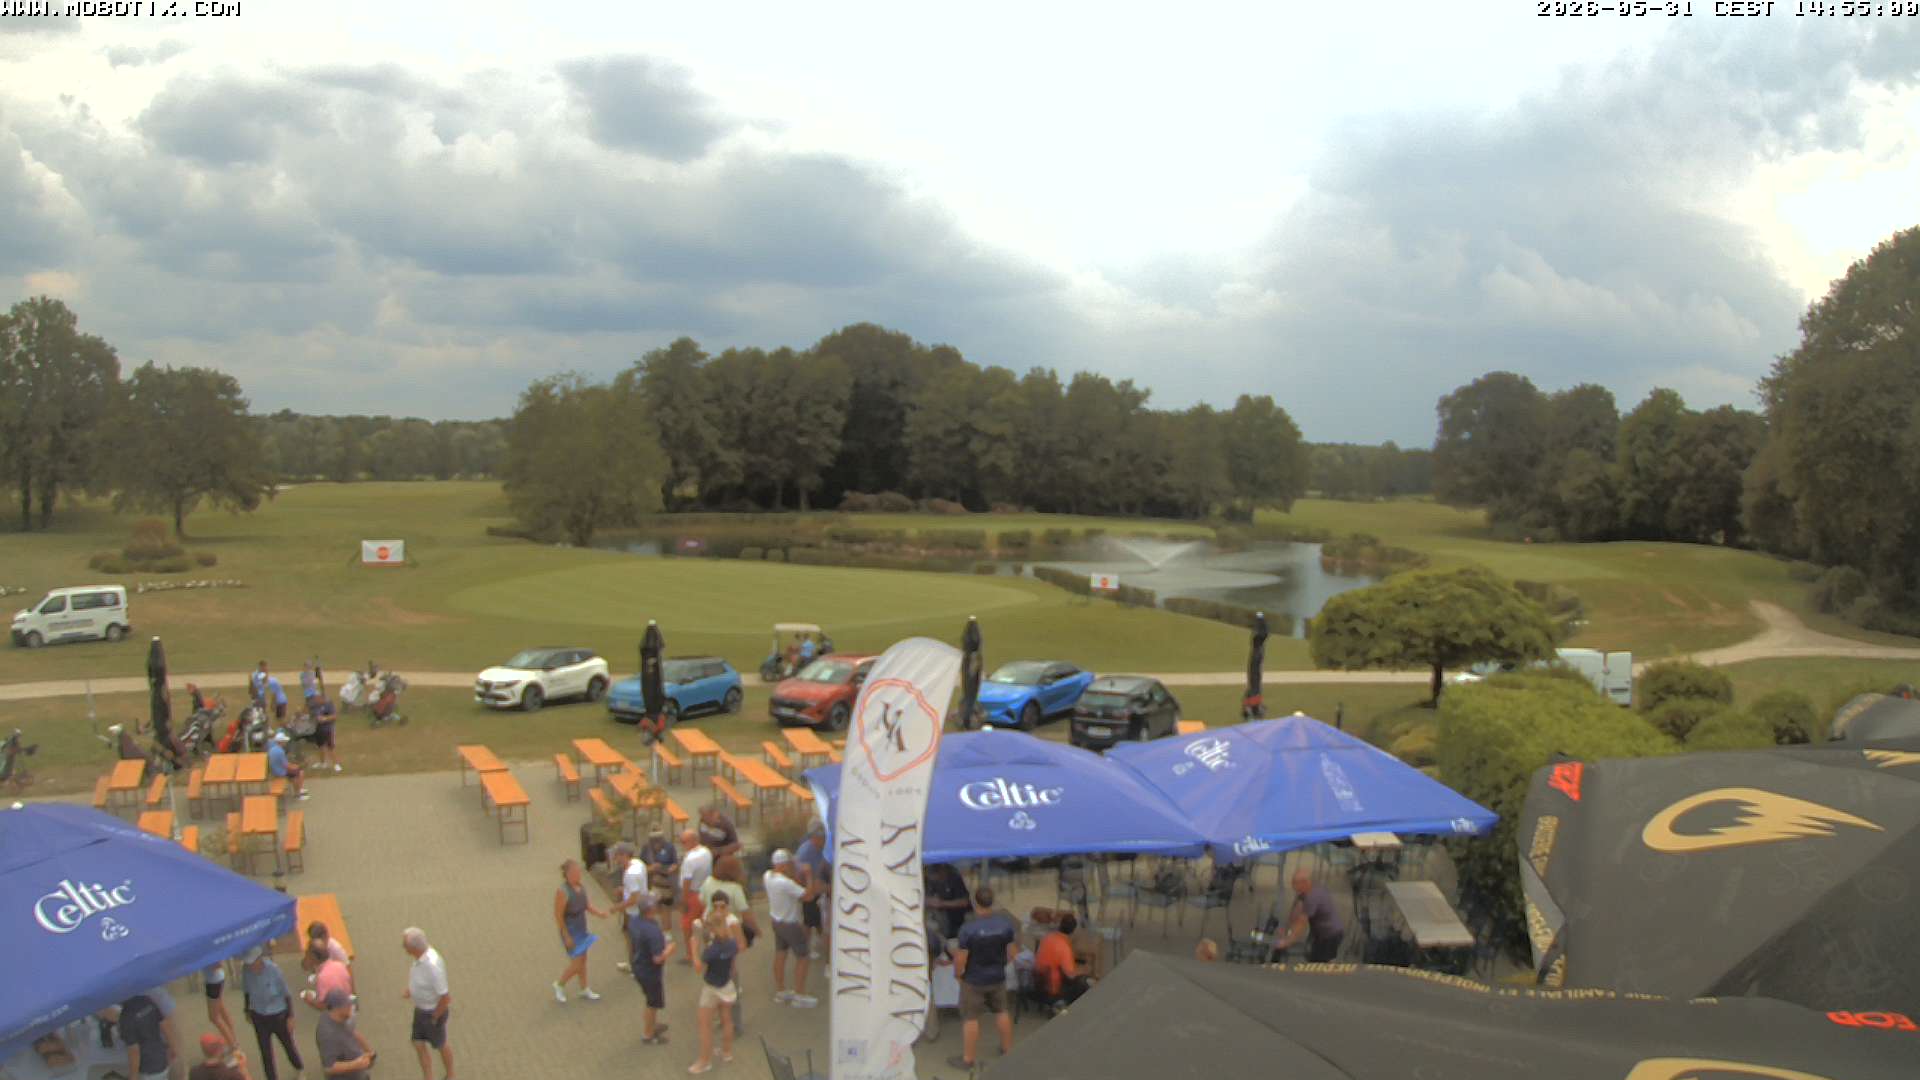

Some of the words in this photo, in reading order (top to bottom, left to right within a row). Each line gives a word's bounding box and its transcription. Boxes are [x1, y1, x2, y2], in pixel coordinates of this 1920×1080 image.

[959, 776, 1062, 812] Celtic
[34, 878, 136, 933] Celtic
[836, 820, 872, 1003] MAISON
